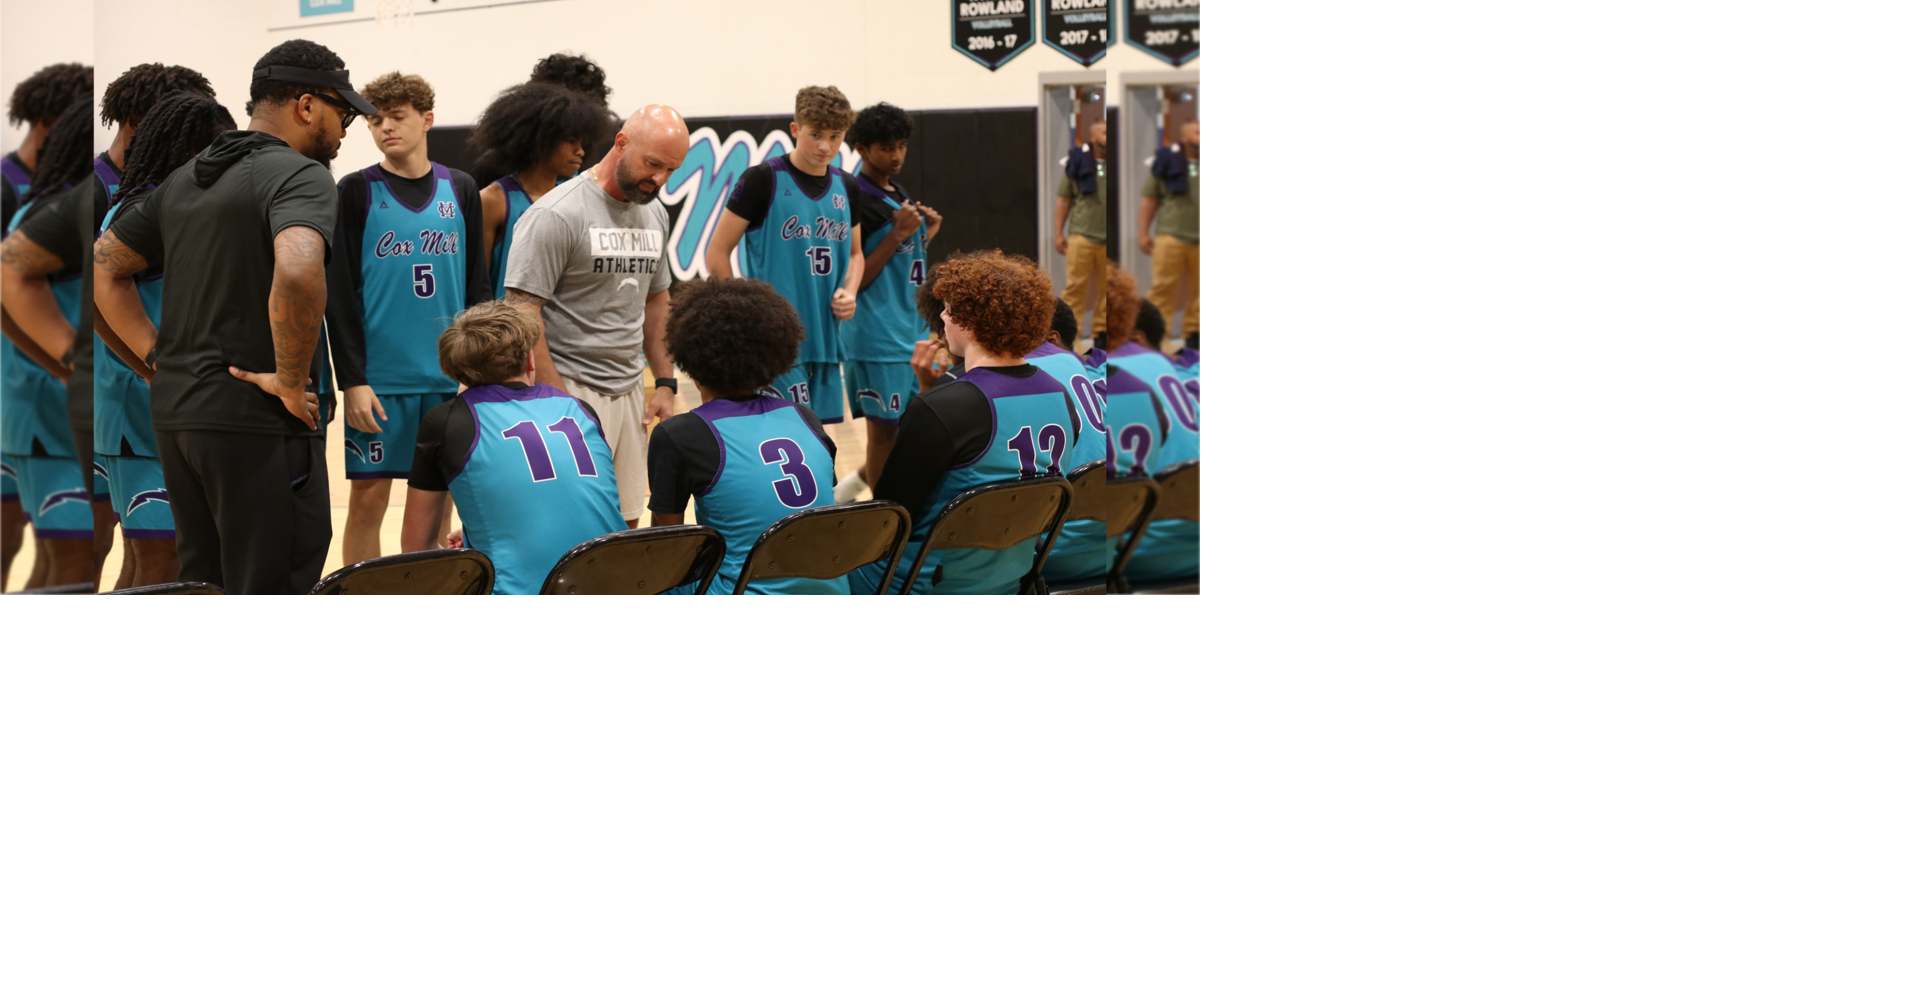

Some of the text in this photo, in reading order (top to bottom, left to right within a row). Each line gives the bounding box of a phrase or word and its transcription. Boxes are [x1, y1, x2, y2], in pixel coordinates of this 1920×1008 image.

[960, 0, 1025, 17] ROWLAND
[968, 35, 995, 50] 2016
[1004, 34, 1018, 48] 17
[1060, 30, 1089, 45] 2017
[1098, 29, 1106, 43] 1
[781, 215, 811, 240] Cox
[375, 229, 458, 259] Cox Mill
[598, 232, 658, 252] COX MILL
[805, 246, 832, 276] 15
[909, 259, 926, 287] 4
[412, 263, 435, 298] 5
[788, 382, 810, 404] 15
[889, 393, 900, 412] 4
[1070, 374, 1106, 433] 0
[368, 441, 384, 464] 5
[501, 416, 598, 483] 11
[759, 438, 818, 508] 3
